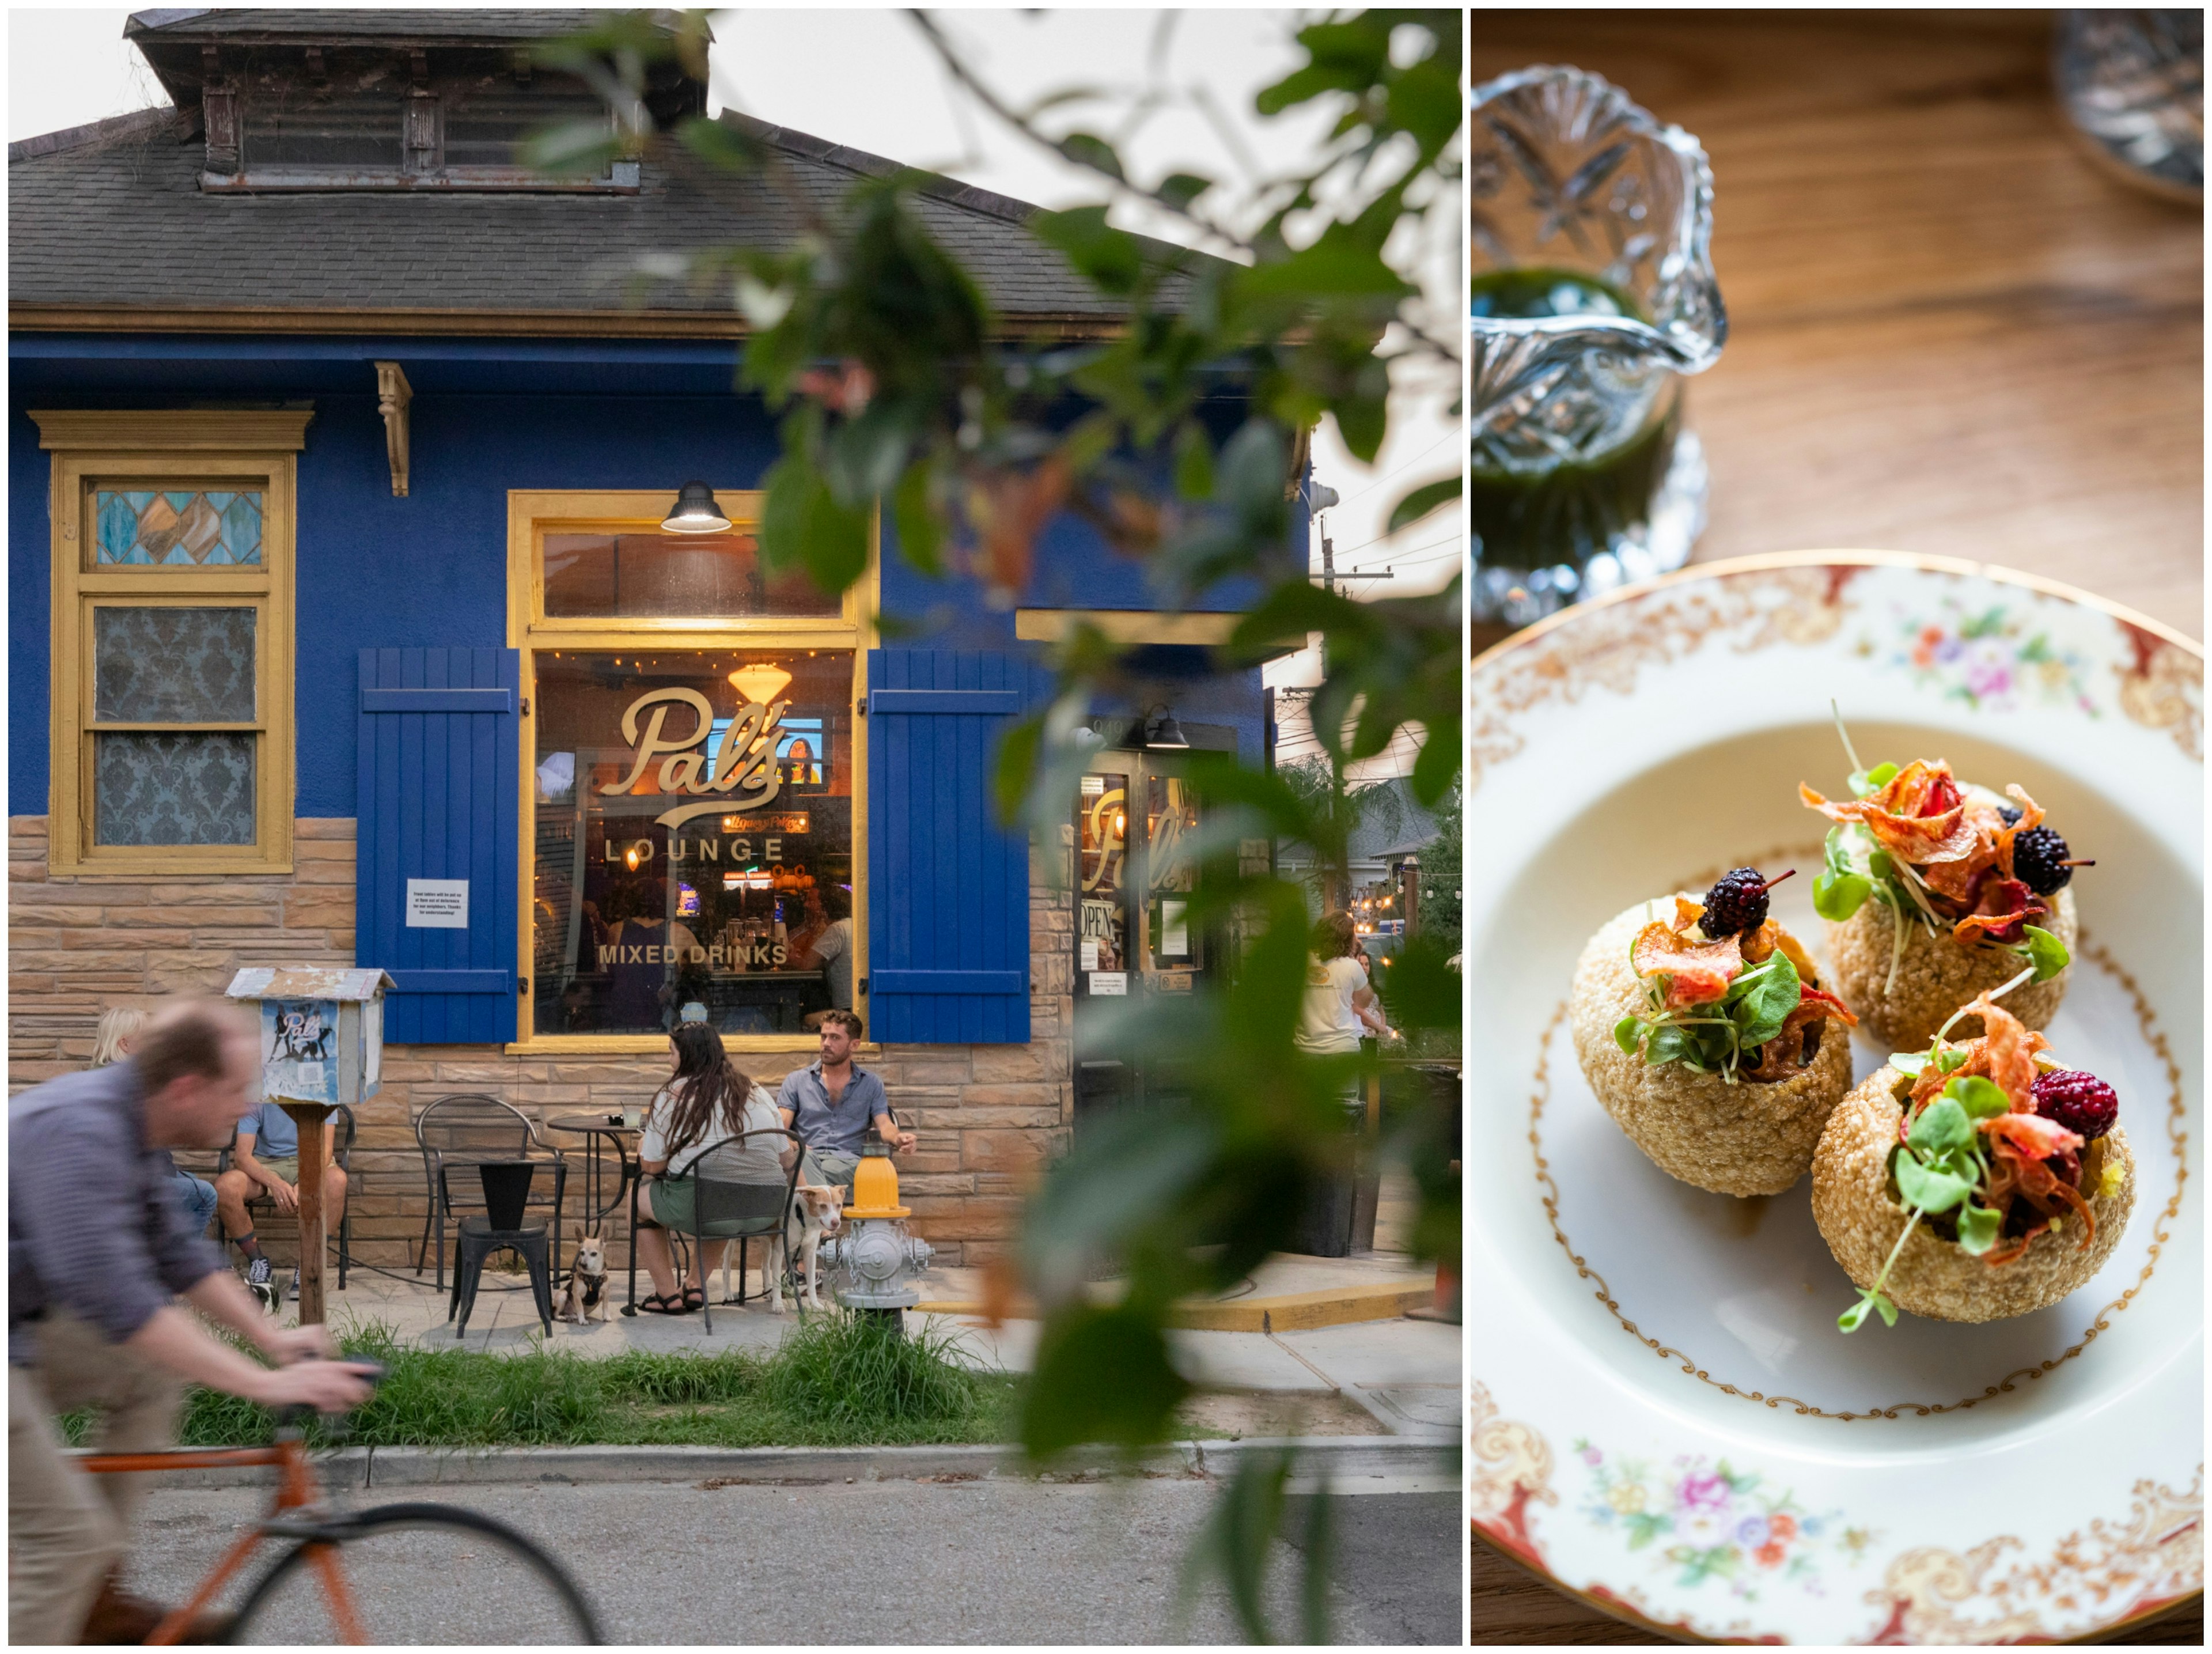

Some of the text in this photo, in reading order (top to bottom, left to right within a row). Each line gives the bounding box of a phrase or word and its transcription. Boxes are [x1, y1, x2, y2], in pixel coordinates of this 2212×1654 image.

[600, 687, 785, 830] Pal's
[605, 838, 782, 861] LOUNGE
[1081, 905, 1111, 938] OPEN
[599, 945, 787, 964] MIXED DRINKS
